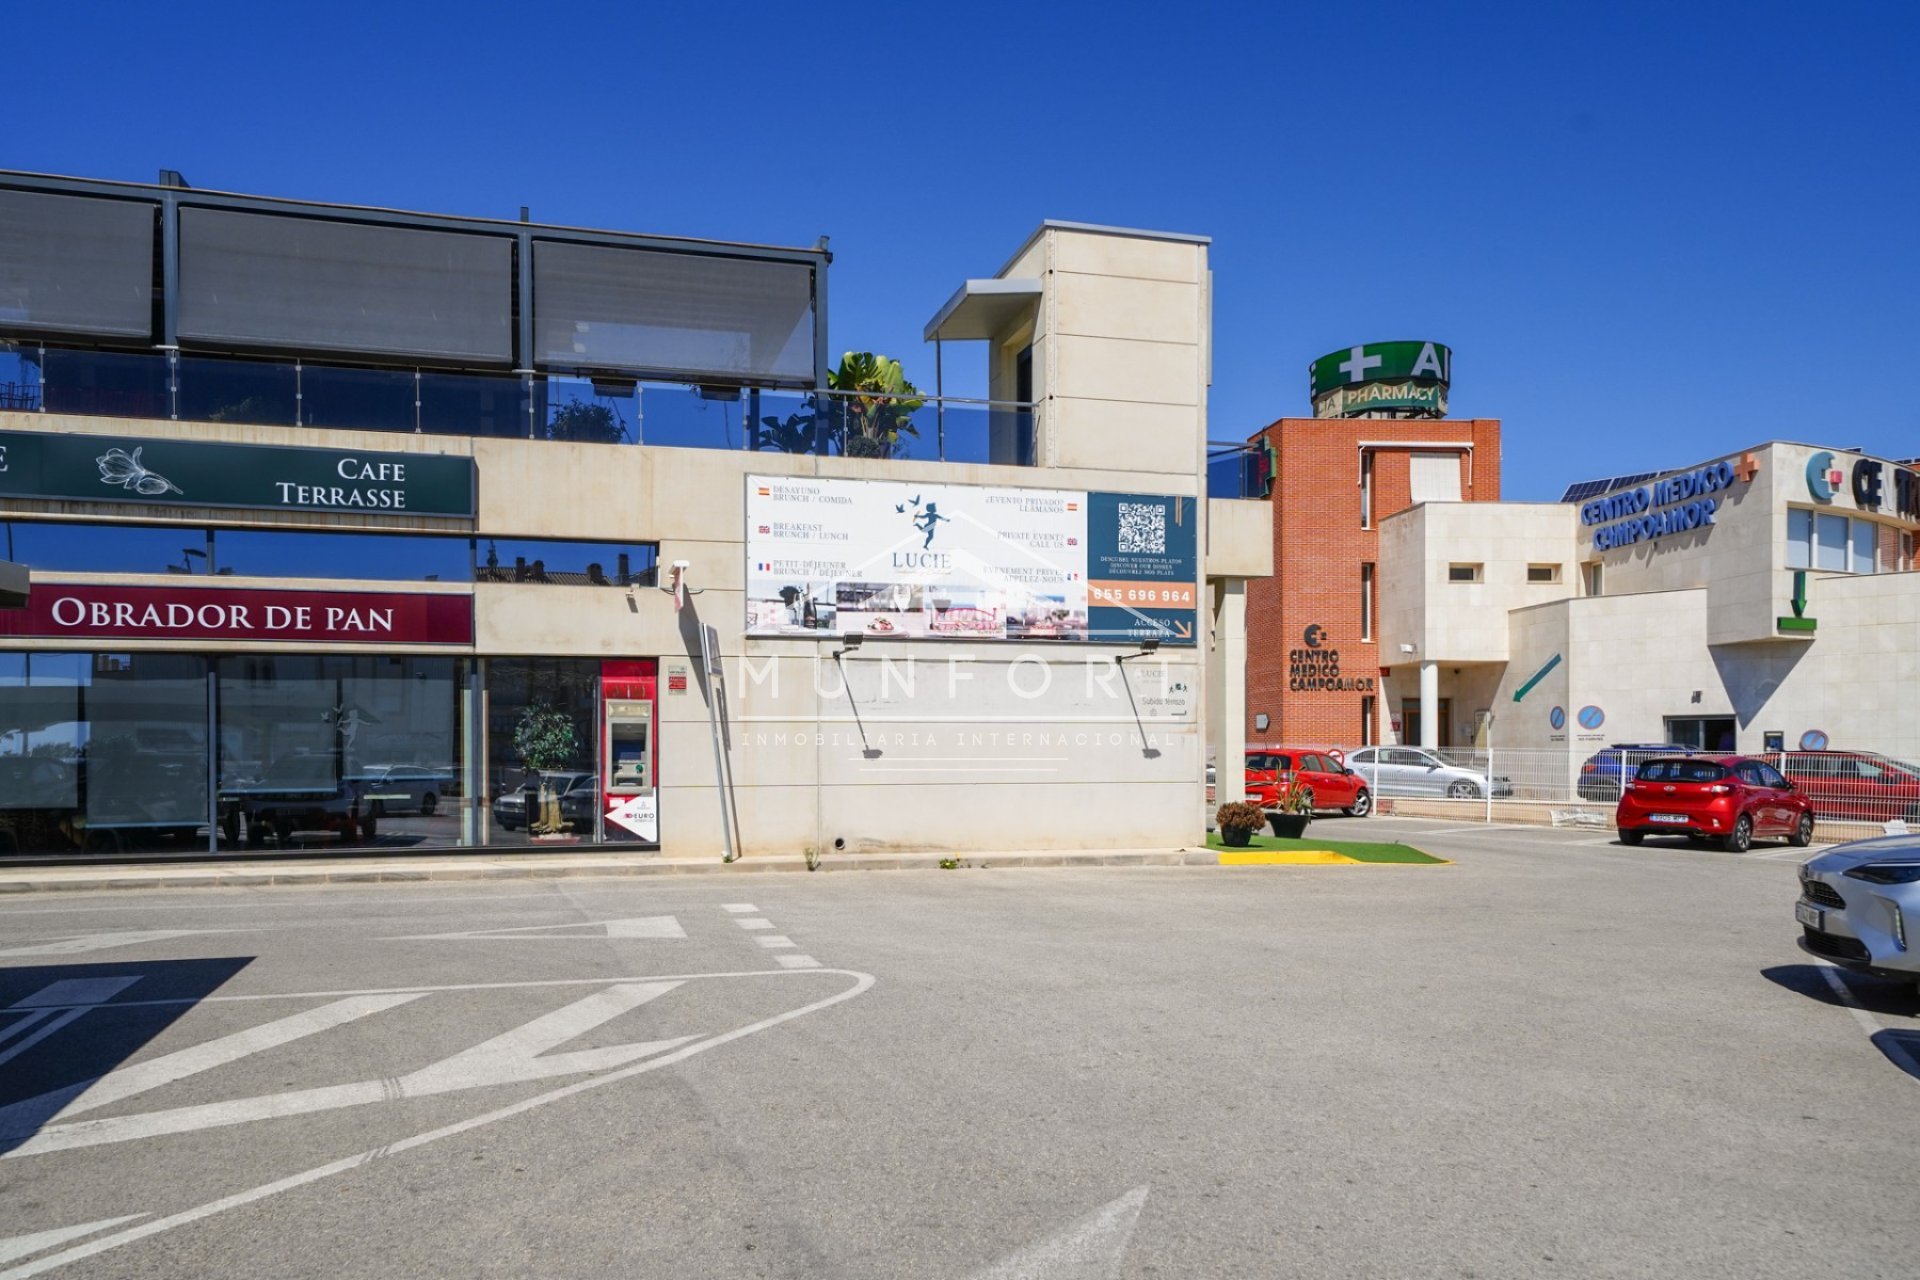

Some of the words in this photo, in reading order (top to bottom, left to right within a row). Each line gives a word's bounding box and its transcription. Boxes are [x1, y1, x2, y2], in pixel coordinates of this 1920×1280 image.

[1348, 385, 1435, 405] PHARMACY
[337, 458, 405, 482] CAFE
[276, 481, 406, 509] TERRASSE
[773, 486, 820, 495] DESAYUNO
[1581, 487, 1650, 526] CENTRO
[1654, 461, 1734, 507] MEDICO
[773, 494, 809, 502] BRUNCH
[819, 496, 853, 504] COMIDA
[773, 522, 823, 531] BREAKFAST
[1593, 498, 1717, 550] CAMPOAMOR
[773, 531, 809, 539] BRUNCH
[819, 532, 849, 541] LUNCH
[1030, 540, 1051, 548] CALL
[1054, 541, 1064, 549] US
[893, 552, 952, 568] LUCIE
[773, 568, 809, 576] BRUNCH
[1128, 590, 1156, 601] 696
[1161, 591, 1190, 602] 964
[52, 597, 254, 629] OBRADOR
[265, 606, 313, 630] DE
[326, 607, 394, 632] PAN
[1134, 618, 1171, 627] ACCESO
[1290, 649, 1339, 663] CENTRO
[1290, 663, 1339, 677] MEDICO
[1290, 677, 1374, 691] CAMPOAMOR
